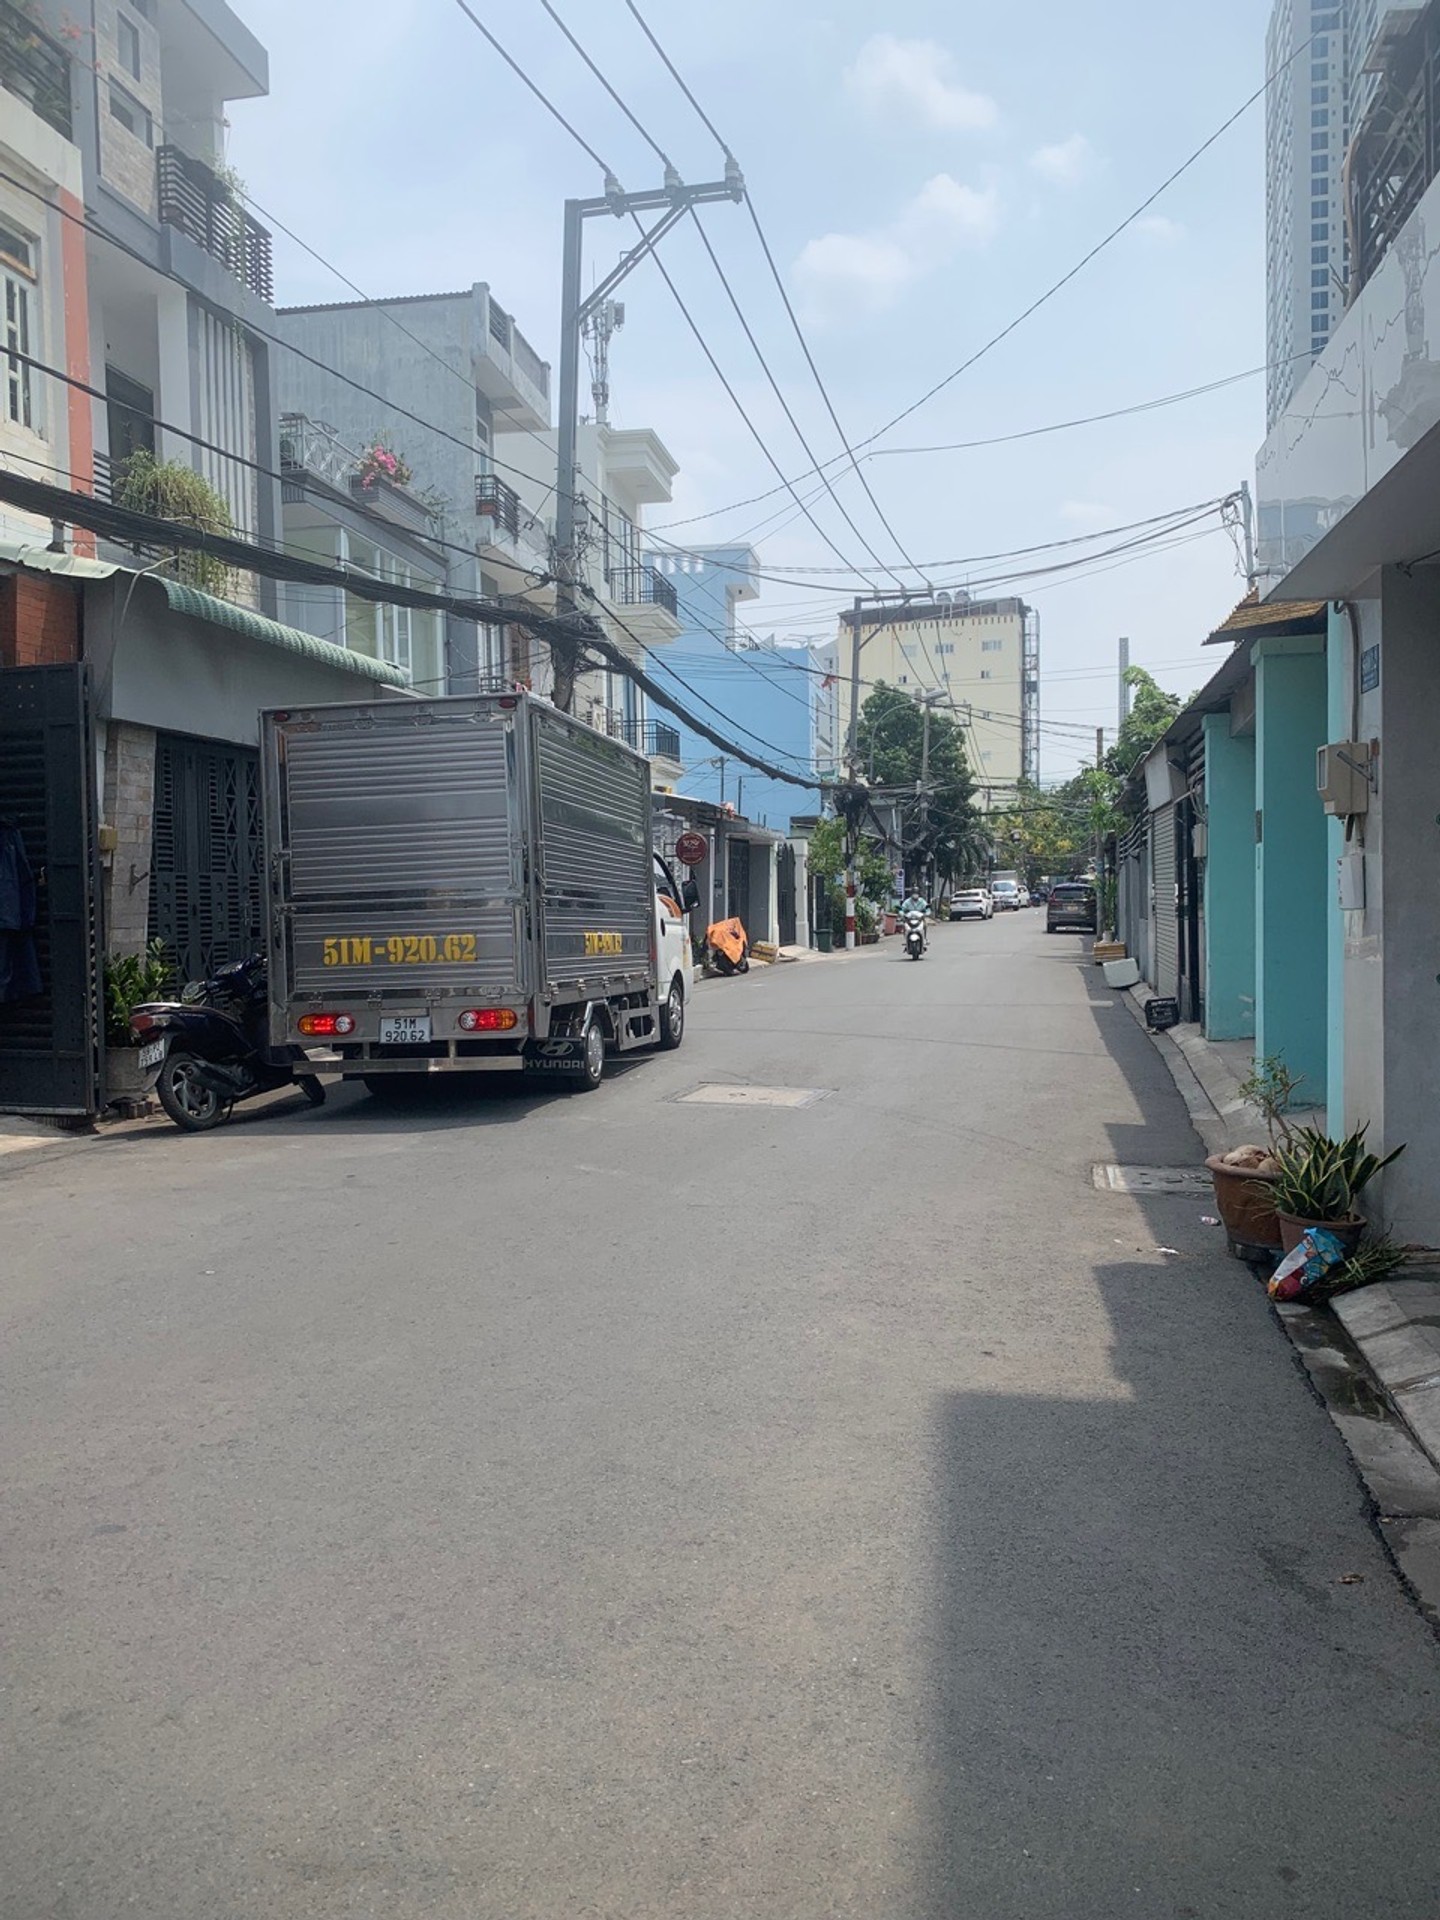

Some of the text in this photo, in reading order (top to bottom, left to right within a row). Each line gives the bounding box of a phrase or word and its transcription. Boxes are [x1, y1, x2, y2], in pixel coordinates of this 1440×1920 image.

[323, 934, 477, 966] 51M-920.62
[394, 1018, 416, 1029] 51M
[524, 1059, 585, 1069] HYUNDAI
